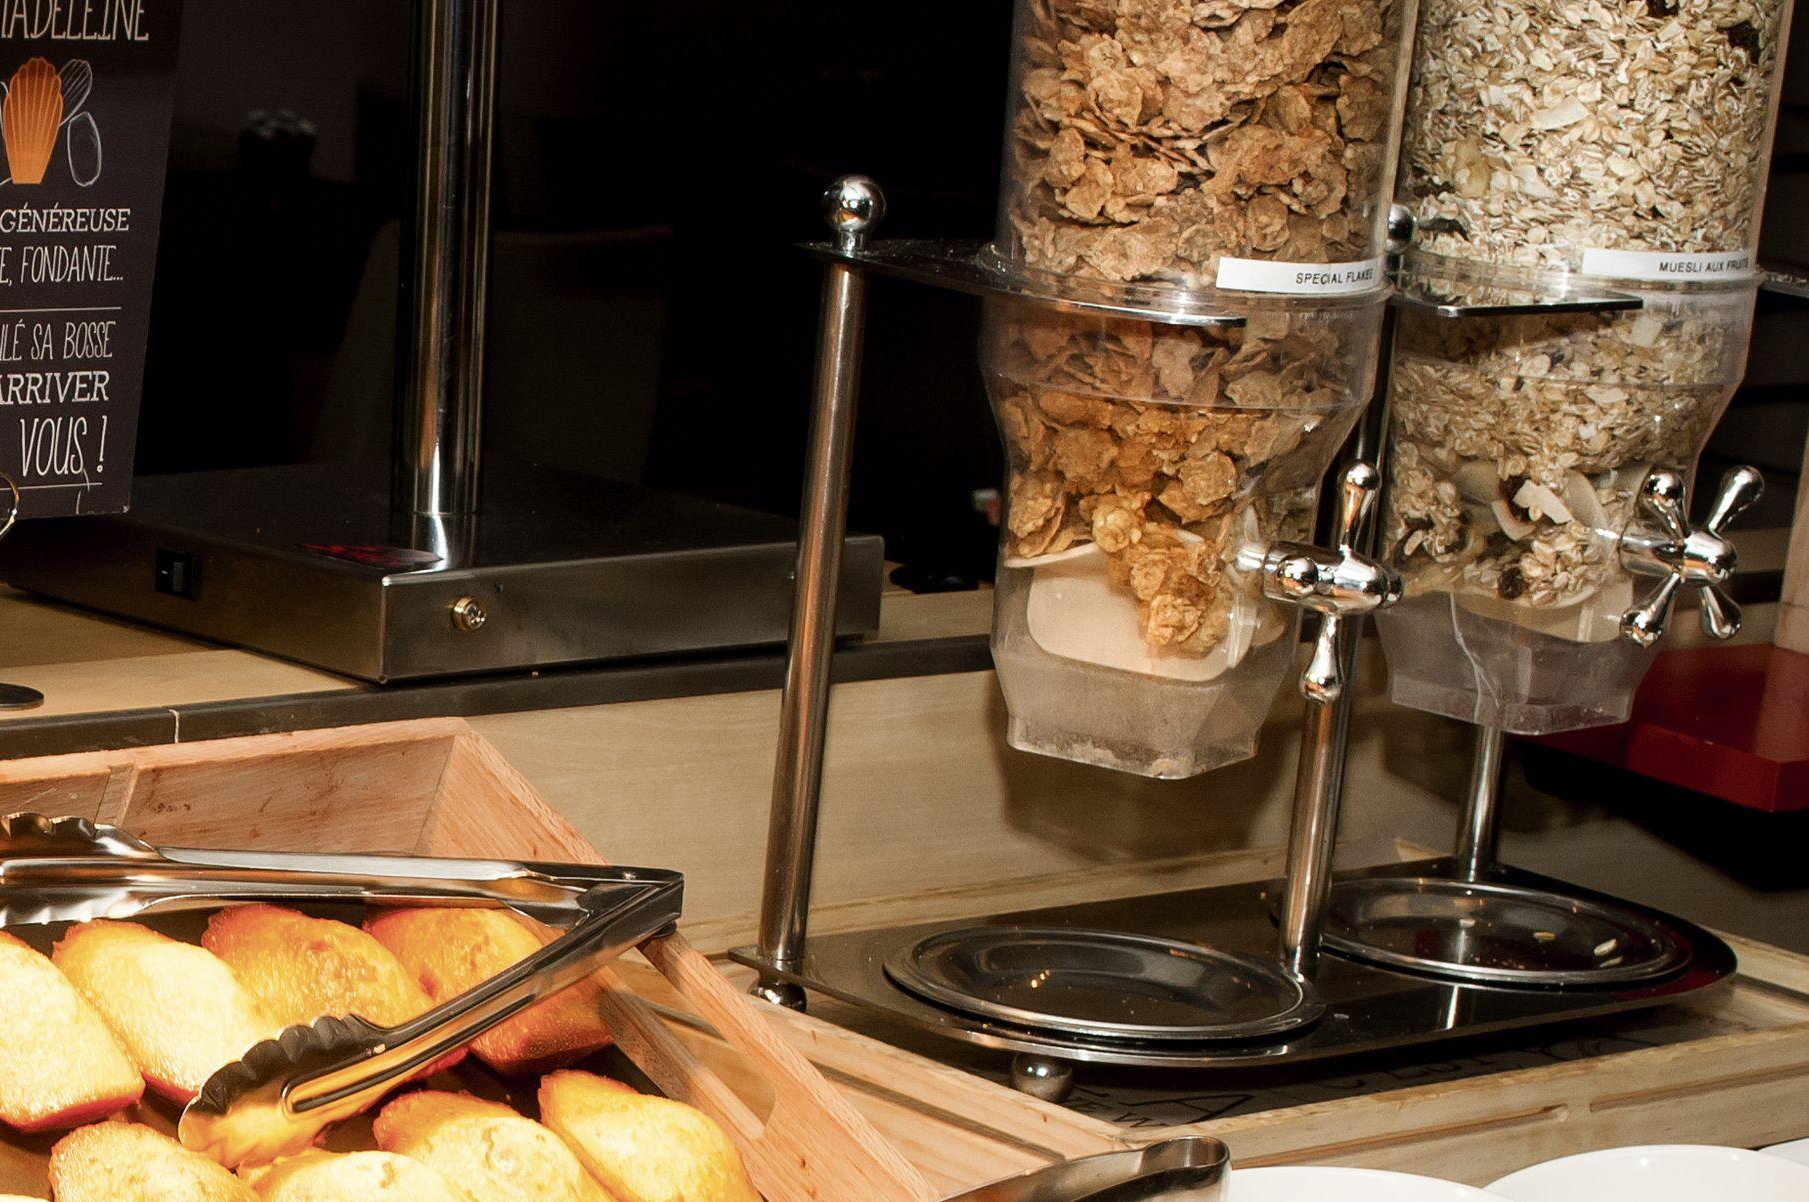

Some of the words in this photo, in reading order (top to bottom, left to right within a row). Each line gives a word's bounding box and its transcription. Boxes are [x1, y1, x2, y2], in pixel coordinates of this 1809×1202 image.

[20, 243, 124, 284] FONDANTE...
[1295, 272, 1343, 285] SPECIAL
[1659, 261, 1703, 273] MUESLI
[1705, 262, 1724, 272] AUX
[30, 323, 55, 361] SA
[62, 320, 117, 360] BOSSE
[19, 416, 87, 476] VOUS
